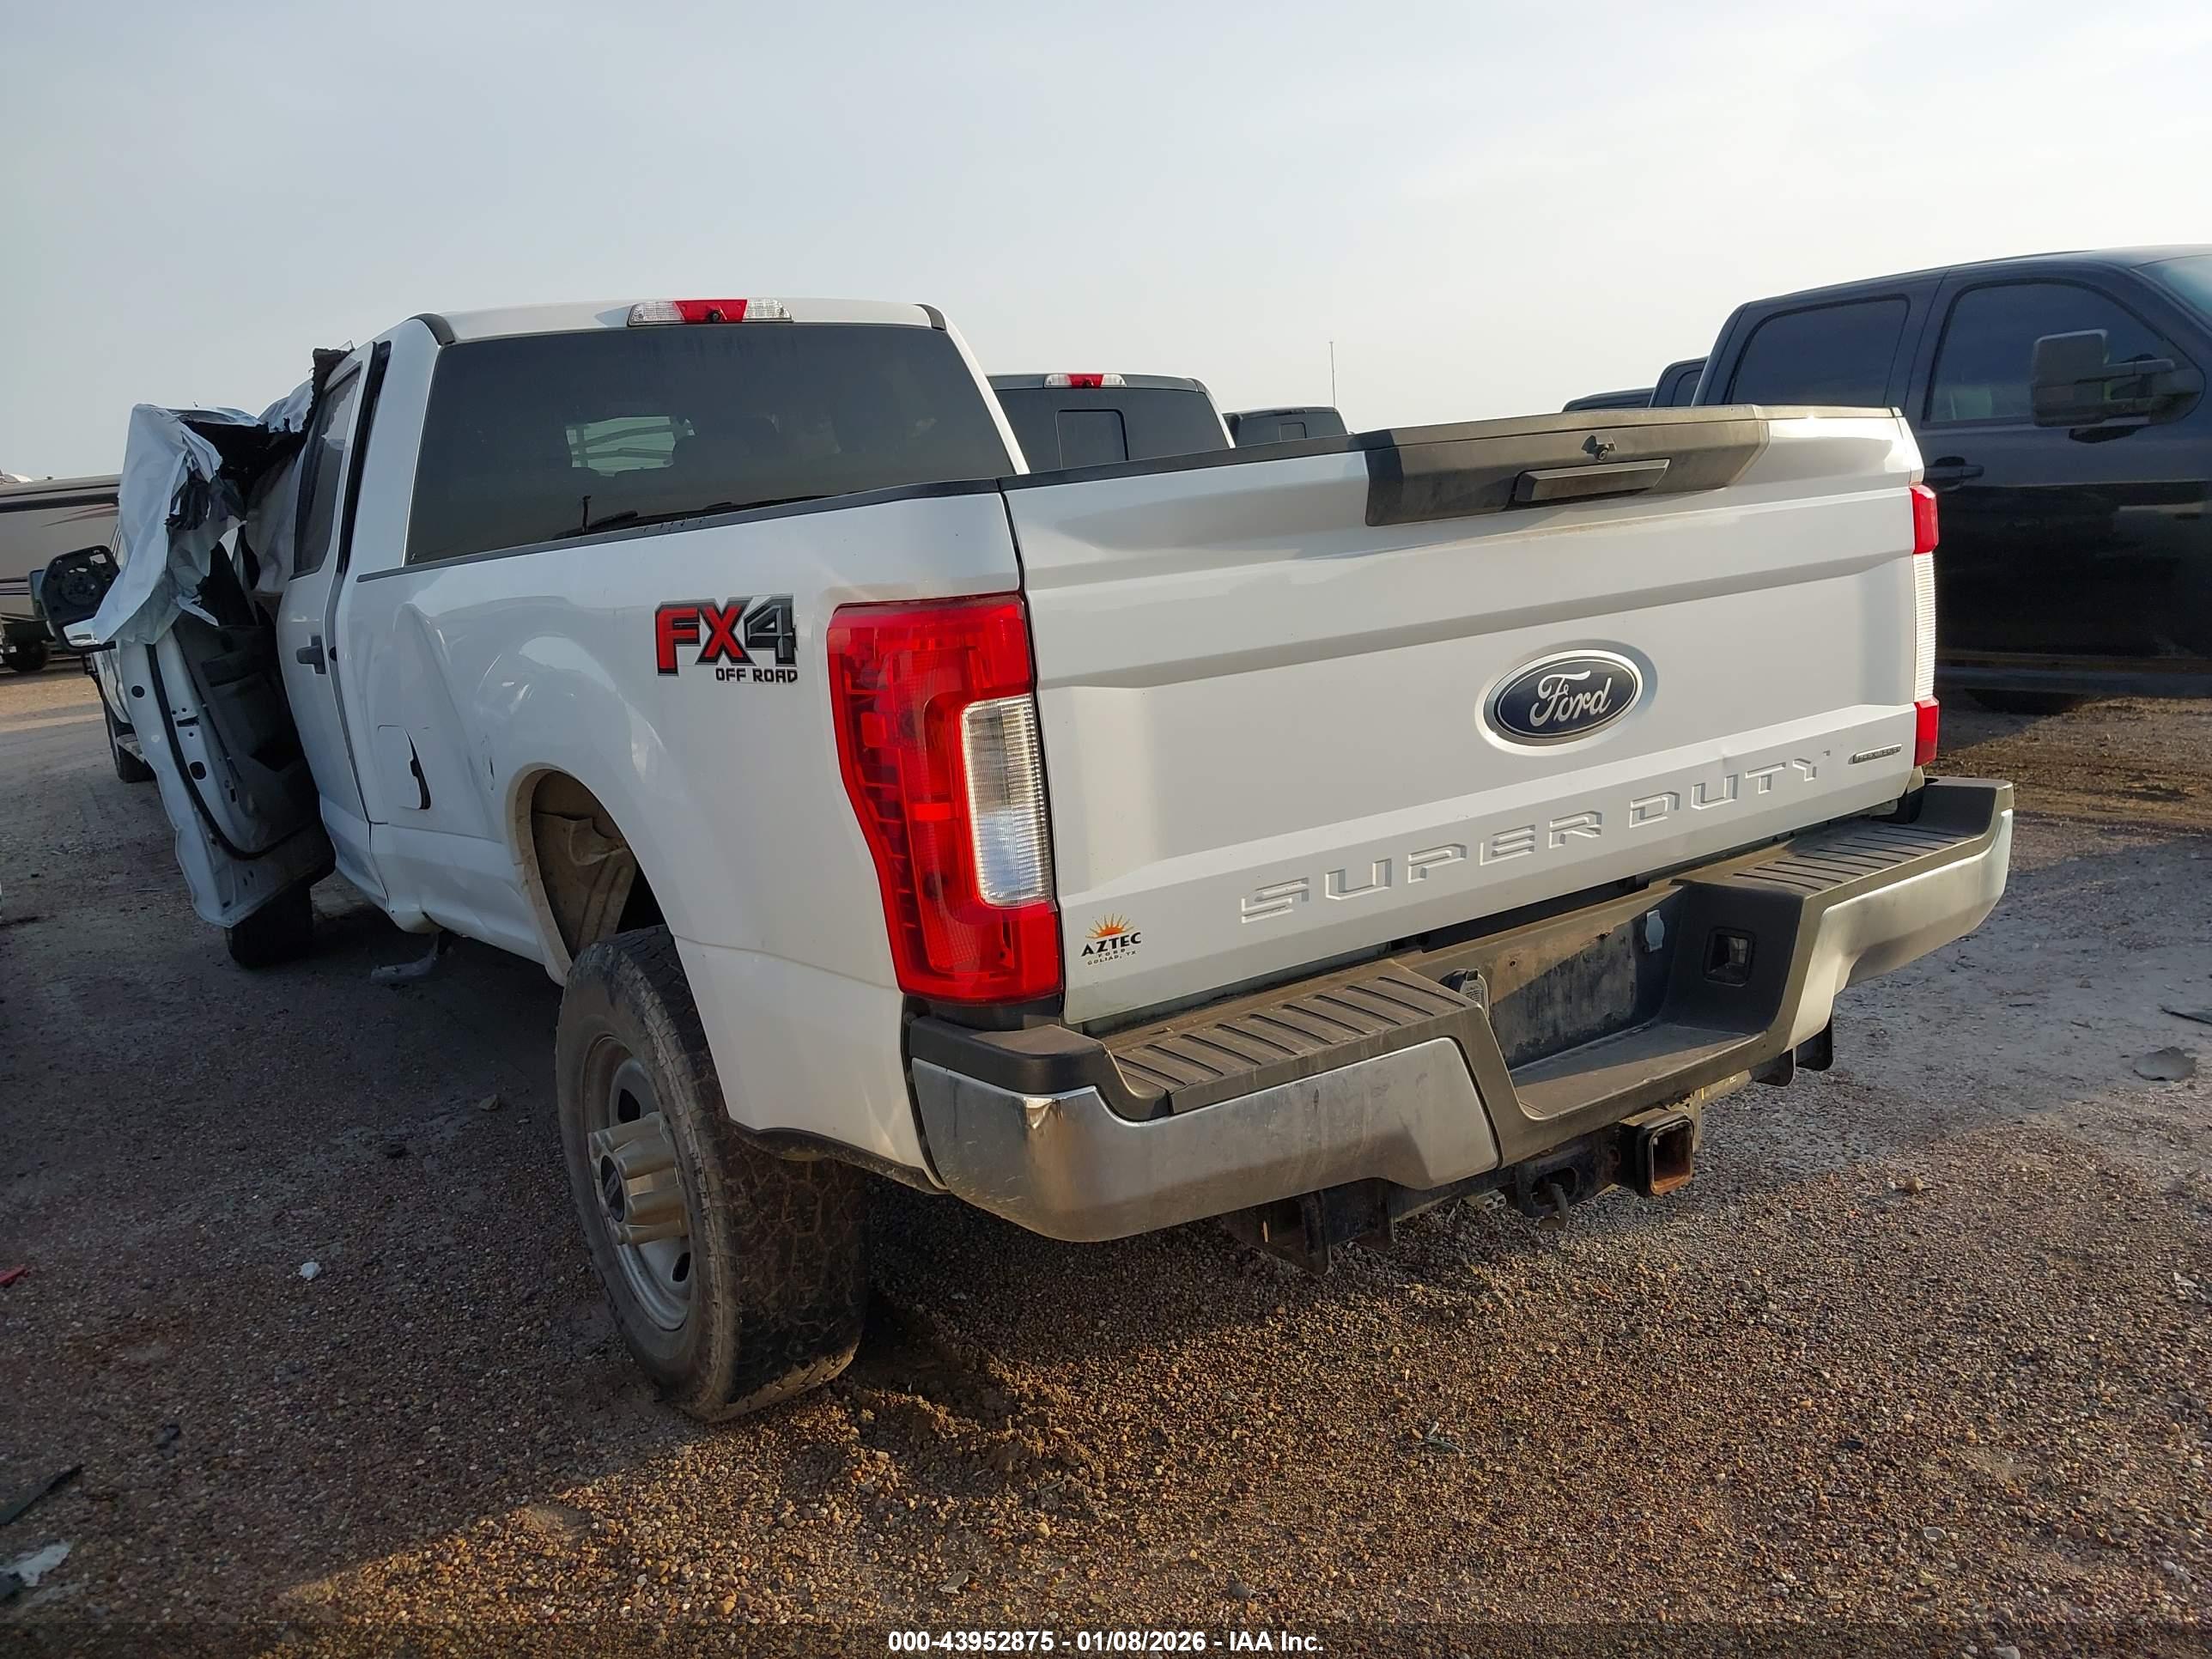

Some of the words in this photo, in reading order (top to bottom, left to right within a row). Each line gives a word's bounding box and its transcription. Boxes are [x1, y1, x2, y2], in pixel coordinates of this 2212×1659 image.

[654, 594, 798, 676] FX4
[715, 668, 746, 682] OFF
[752, 669, 798, 683] ROAD
[1529, 671, 1612, 727] Ford
[1242, 811, 1602, 924] SUPER
[1629, 750, 1831, 829] DUTY
[1081, 932, 1142, 957] AZTEC
